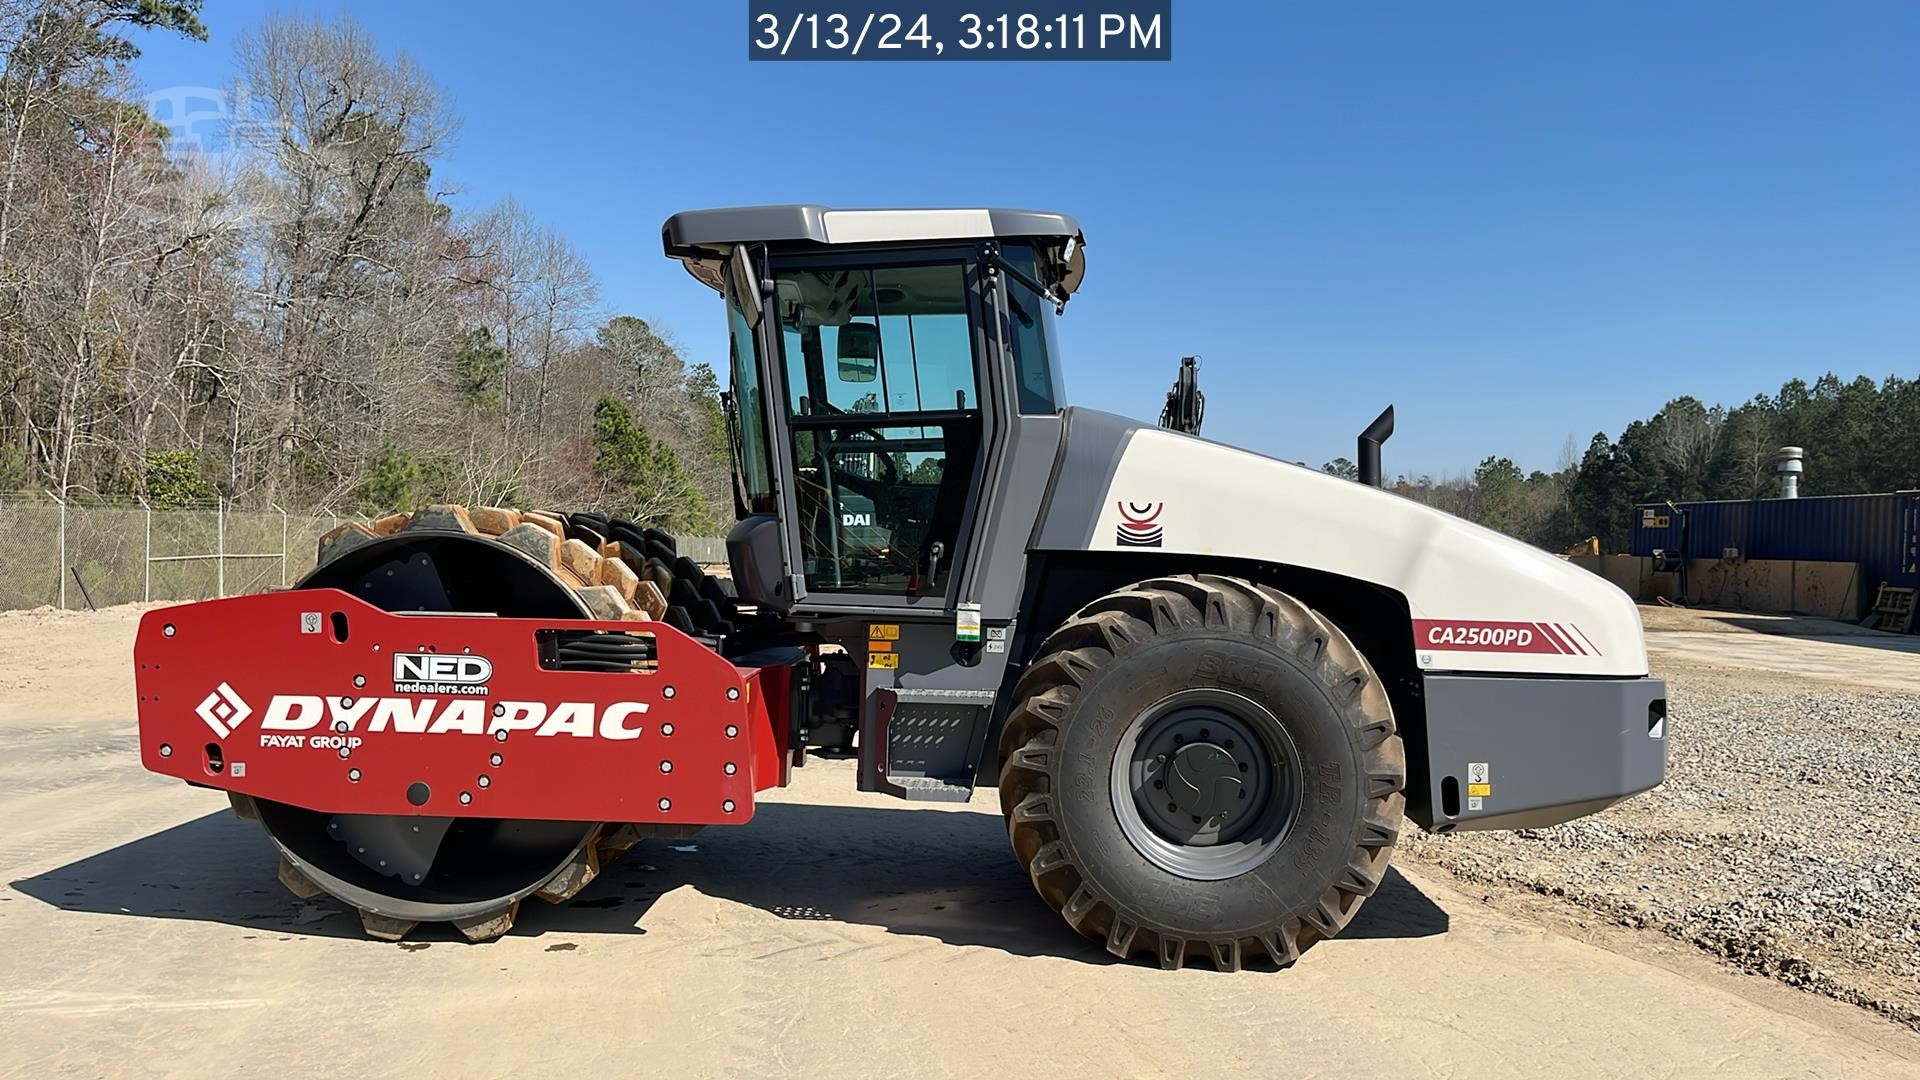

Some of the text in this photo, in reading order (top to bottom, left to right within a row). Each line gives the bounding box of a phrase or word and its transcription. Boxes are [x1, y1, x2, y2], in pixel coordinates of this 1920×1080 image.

[840, 513, 871, 526] DAI
[1428, 626, 1533, 646] CA2500PD
[394, 653, 486, 682] NED
[394, 682, 489, 696] nedealers.com
[260, 694, 650, 741] DYNAPAC
[260, 735, 363, 750] FAYAT GROUP
